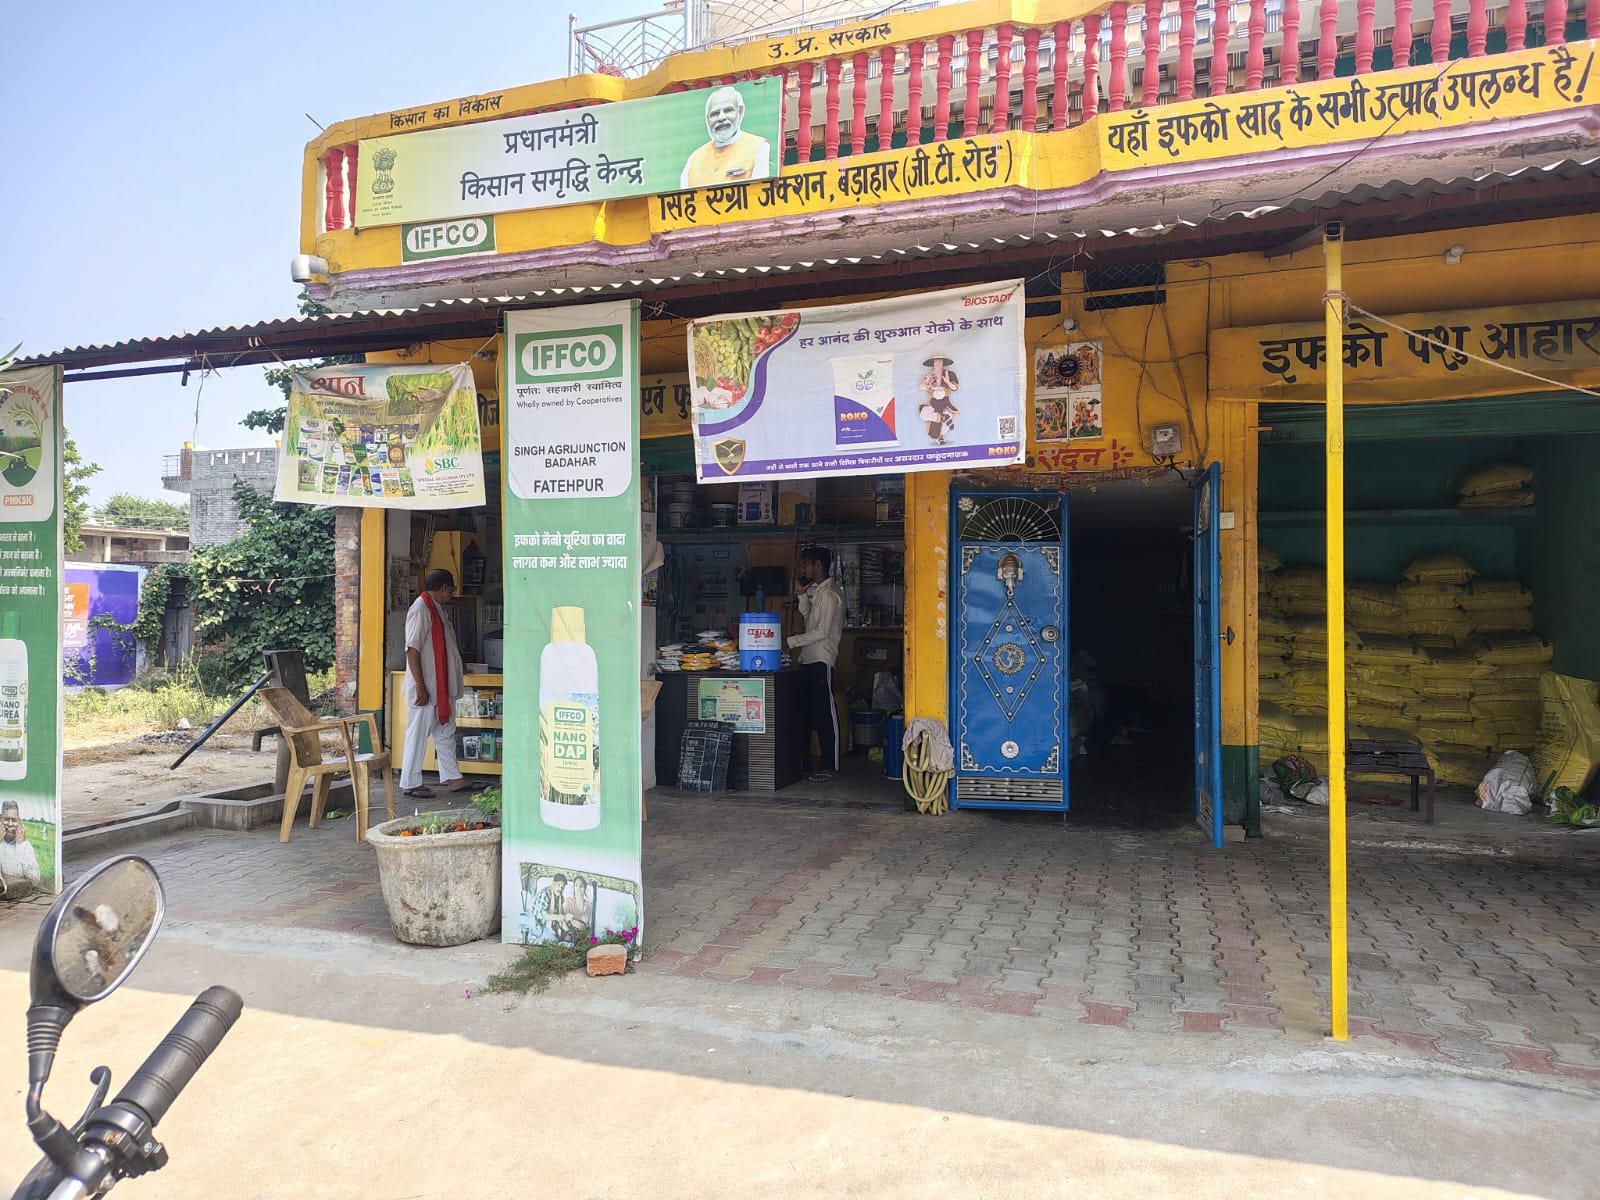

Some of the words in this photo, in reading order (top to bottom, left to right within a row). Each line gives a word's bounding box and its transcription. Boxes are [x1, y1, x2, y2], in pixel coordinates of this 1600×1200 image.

[390, 111, 427, 129] किसान
[433, 105, 450, 121] का
[459, 95, 503, 117] विकास
[1108, 109, 1150, 157] यहाँ
[1157, 102, 1230, 156] इफको
[1236, 100, 1286, 141] खाद
[1286, 89, 1313, 131] के
[1316, 79, 1370, 129] सभी
[1370, 78, 1442, 121] उत्पाद
[1443, 62, 1546, 110] उपलब्ध
[503, 112, 599, 154] प्रधानमंत्री
[460, 171, 526, 201] किसान
[531, 157, 591, 199] समृद्धि
[595, 153, 645, 185] केन्द्र
[414, 223, 479, 249] IFFCO
[963, 293, 1013, 307] BIOSTADT
[799, 337, 814, 349] हर
[818, 330, 850, 346] आनंद
[853, 327, 870, 341] की
[874, 325, 921, 344] शुरुआत
[925, 319, 955, 334] रोको
[959, 317, 972, 331] के
[977, 315, 1004, 328] साथ
[1404, 324, 1471, 370] पशु
[532, 340, 607, 371] IFFCO
[546, 382, 581, 395] सहकारी
[586, 380, 623, 391] स्वामित्व
[516, 401, 540, 410] Wholly
[542, 400, 564, 408] owned
[566, 399, 575, 408] by
[576, 395, 623, 406] Cooperatives
[840, 411, 868, 421] ROKO
[514, 445, 546, 457] SINGH
[547, 441, 626, 455] AGRIJUNCTION
[988, 445, 1017, 456] ROKO
[434, 456, 460, 469] SBC
[545, 457, 596, 468] BADAHAR
[534, 478, 604, 494] FATEHPUR
[514, 531, 540, 547] इफको
[541, 531, 562, 547] नैनो
[563, 531, 591, 551] यूरिया
[592, 533, 605, 546] का
[606, 533, 626, 546] वादा
[512, 556, 538, 569] लागत
[539, 556, 557, 569] कम
[559, 553, 576, 569] और
[578, 556, 600, 569] लाभ
[601, 556, 628, 569] ज्यादा
[559, 711, 581, 720] IFFCO
[553, 731, 588, 743] NANO
[555, 745, 586, 759] DAP
